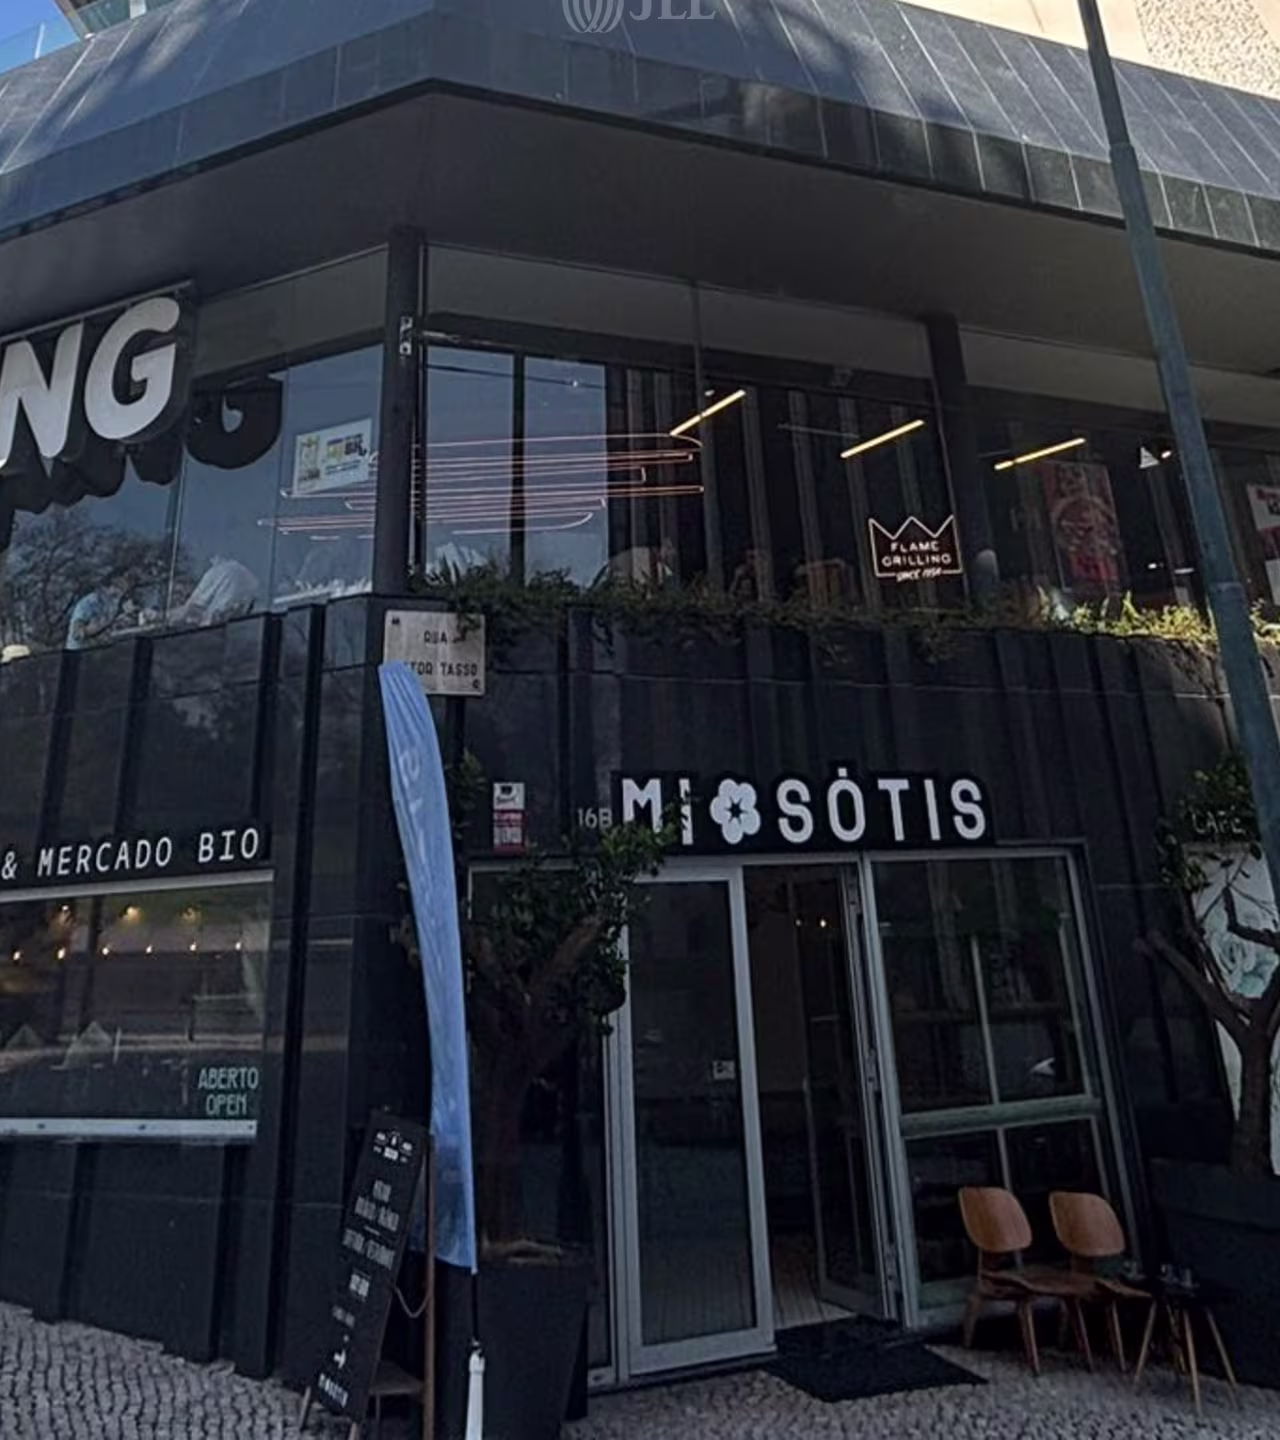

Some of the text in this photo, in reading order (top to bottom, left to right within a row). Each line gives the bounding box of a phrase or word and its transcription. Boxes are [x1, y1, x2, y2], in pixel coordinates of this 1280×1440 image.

[890, 541, 939, 553] FLAME
[881, 553, 952, 567] GRILLING
[440, 662, 478, 677] TASSO
[577, 807, 613, 830] 16B
[1, 850, 18, 880] &
[37, 836, 173, 877] MERCADO
[198, 827, 260, 863] BIO
[198, 1066, 259, 1090] ABERTO
[206, 1093, 247, 1116] OPEN
